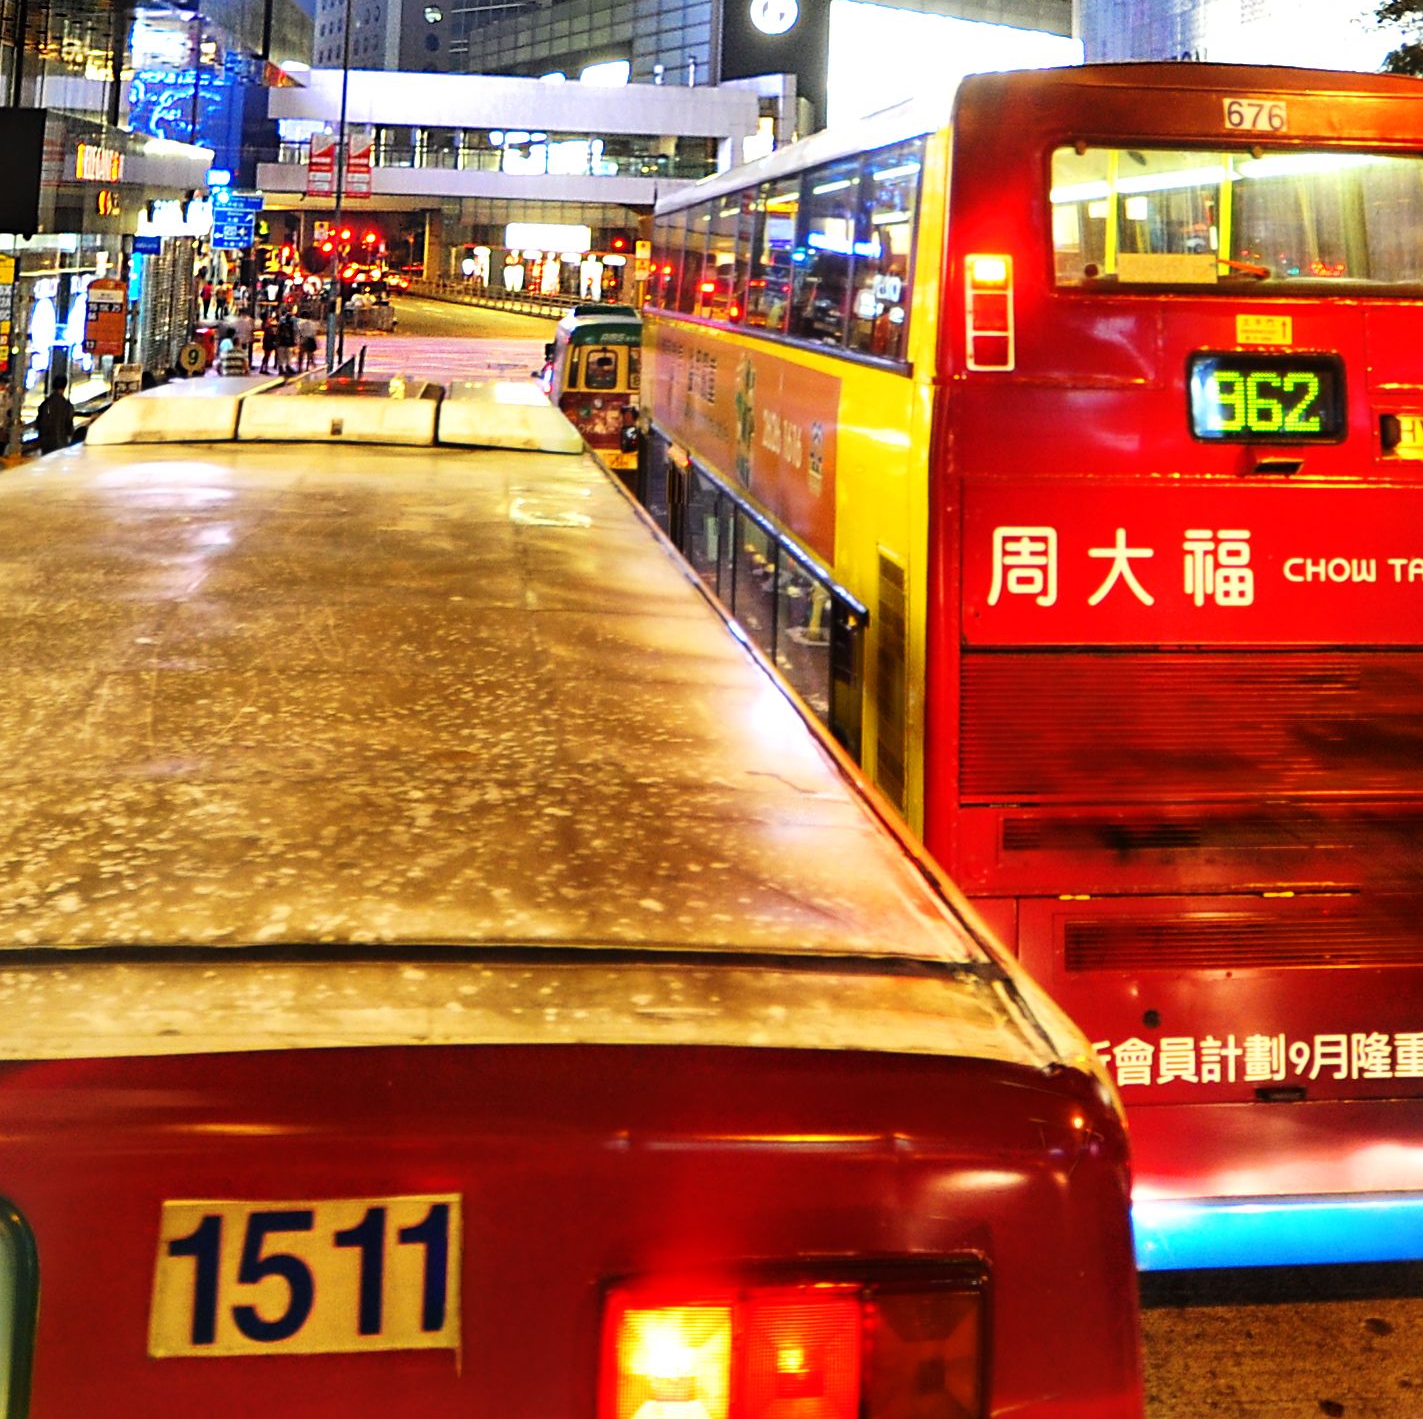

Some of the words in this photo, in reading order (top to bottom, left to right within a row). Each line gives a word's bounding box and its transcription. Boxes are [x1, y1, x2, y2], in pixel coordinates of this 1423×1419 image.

[1227, 100, 1284, 132] 676
[1214, 371, 1320, 432] 962
[987, 526, 1254, 606] 周大福
[1283, 557, 1376, 583] CHOW
[168, 1203, 449, 1345] 1511
